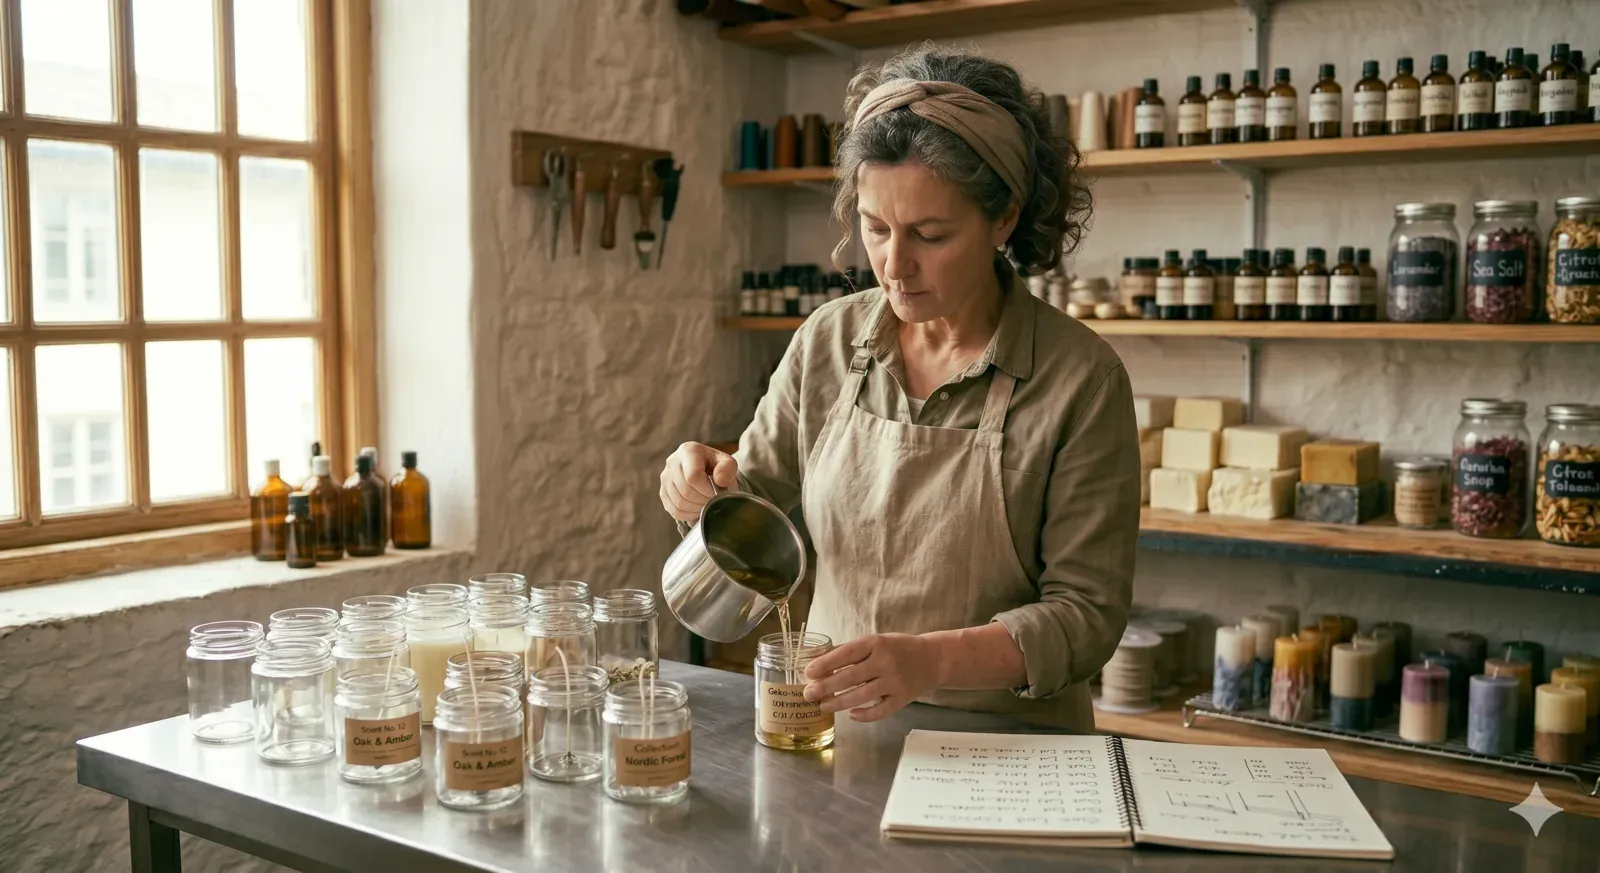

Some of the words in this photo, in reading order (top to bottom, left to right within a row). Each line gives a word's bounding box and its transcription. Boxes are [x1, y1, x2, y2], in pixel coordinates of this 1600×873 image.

[1473, 259, 1495, 278] Sea
[1498, 259, 1524, 277] Salt
[361, 726, 382, 734] Scent
[353, 736, 372, 746] Oak
[375, 737, 382, 746] &
[385, 733, 414, 745] Amber
[453, 760, 472, 770] Oak
[476, 761, 483, 770] &
[486, 757, 516, 769] Amber
[625, 756, 659, 766] Nordic
